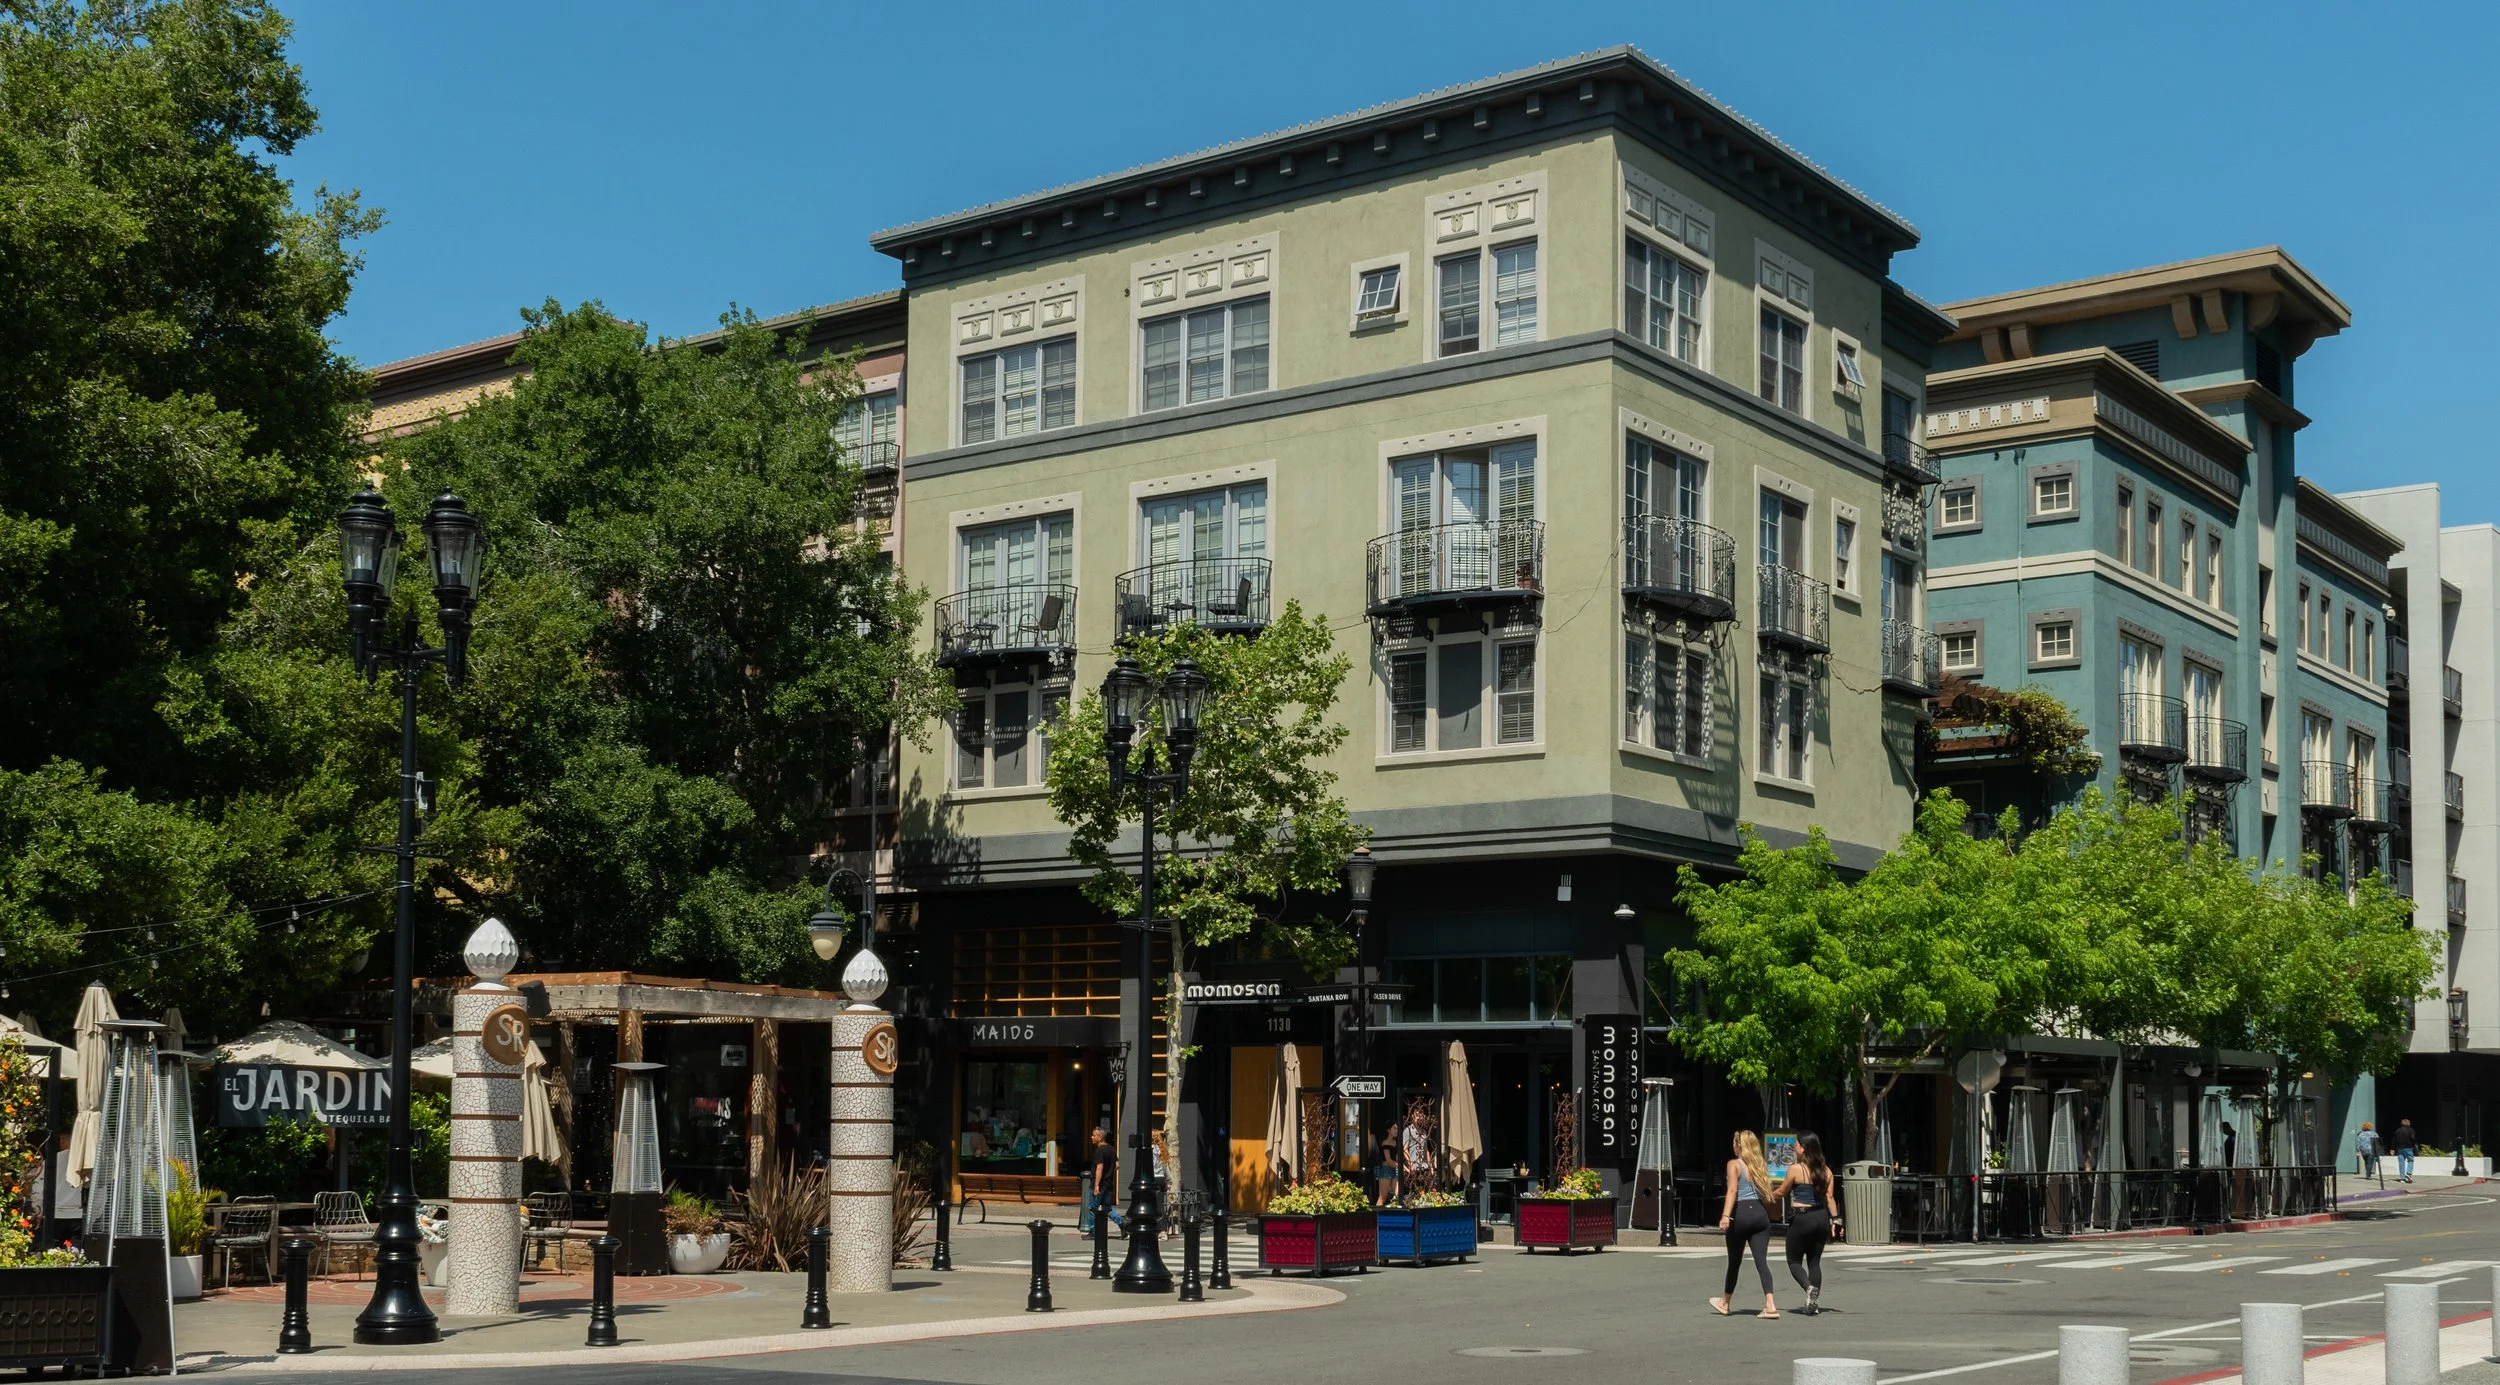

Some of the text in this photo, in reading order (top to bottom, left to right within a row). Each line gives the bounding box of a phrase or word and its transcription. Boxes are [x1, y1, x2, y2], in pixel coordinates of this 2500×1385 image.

[1188, 983, 1280, 998] momosan
[1388, 993, 1402, 1001] DRIVE
[1308, 993, 1349, 1003] SANTANA ROW
[1267, 1018, 1291, 1032] 1130
[496, 1013, 525, 1056] SR
[874, 1031, 896, 1065] SR
[1592, 1049, 1600, 1095] SANTANA
[224, 1077, 240, 1091] EL
[1346, 1082, 1380, 1092] ONE WAY
[1603, 1026, 1615, 1146] momosan
[232, 1067, 391, 1121] JARDIN
[328, 1114, 391, 1124] TEQUILA BA
